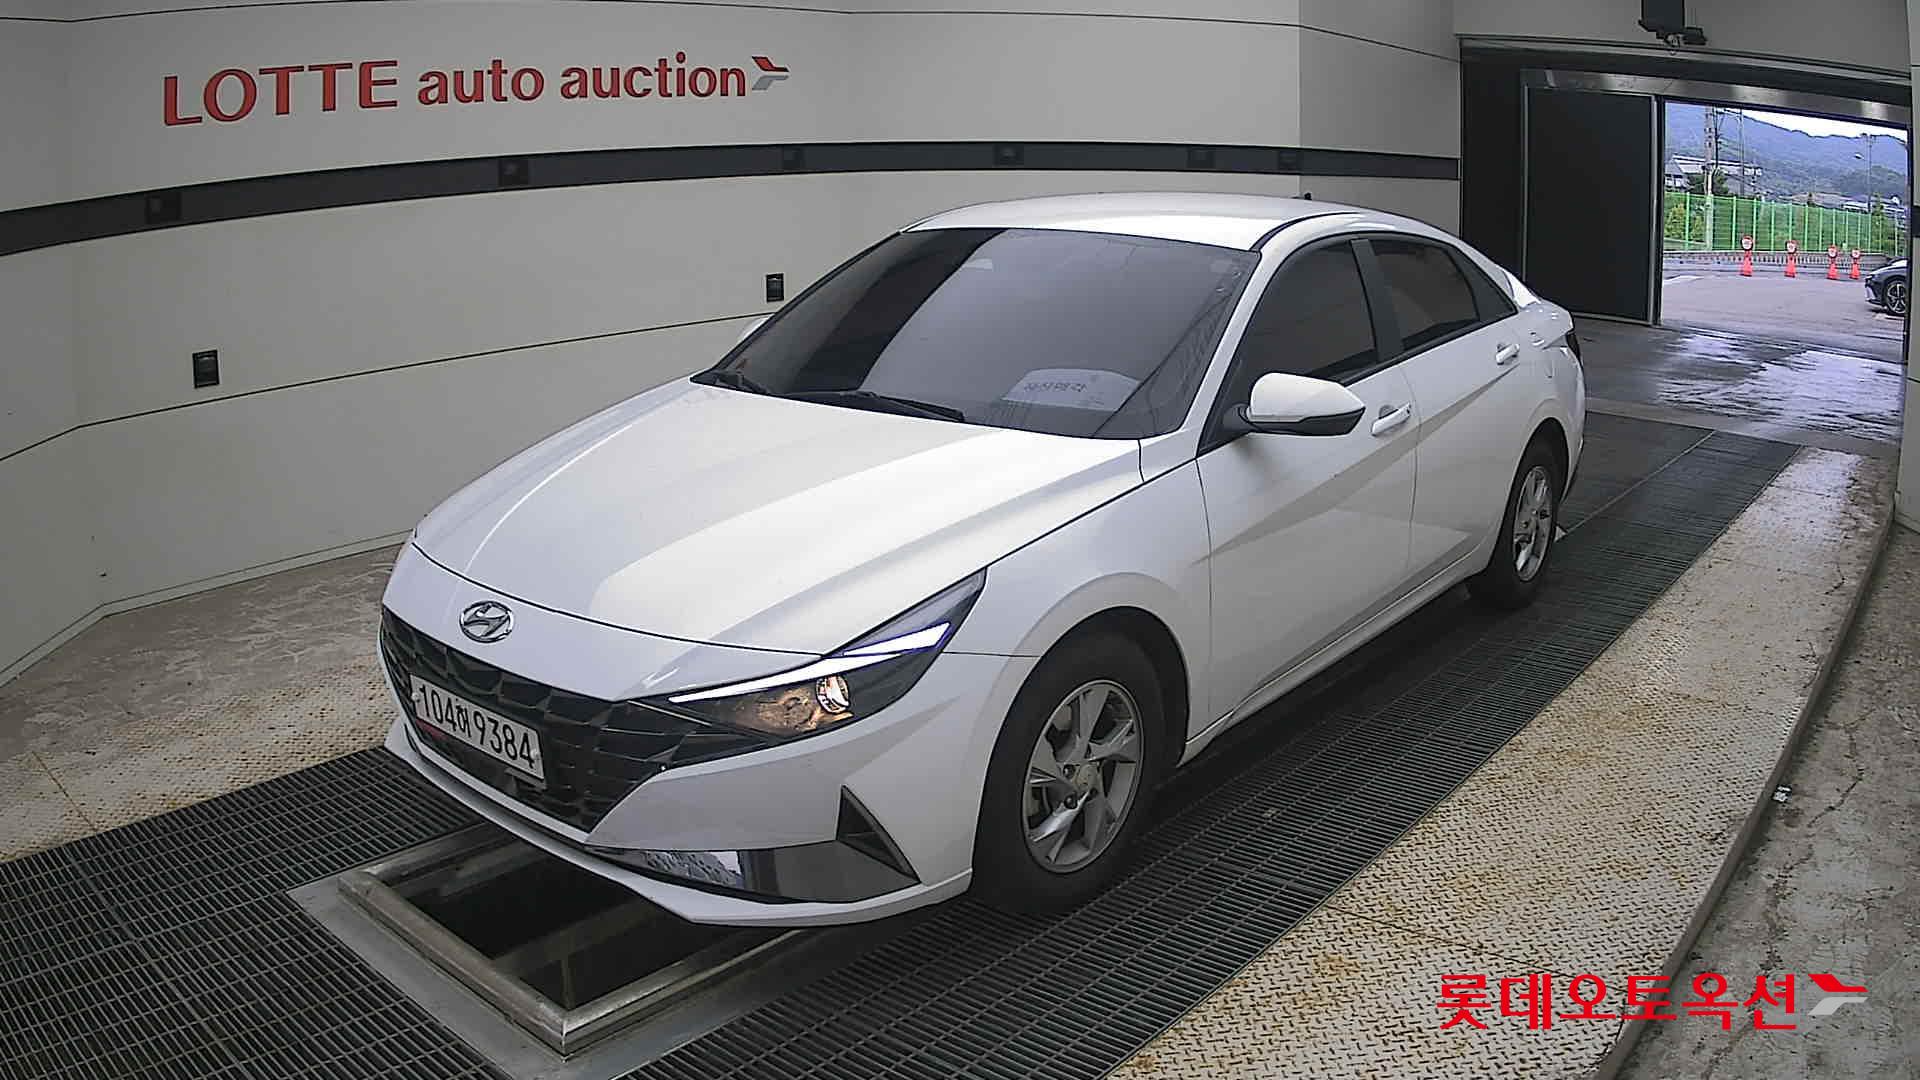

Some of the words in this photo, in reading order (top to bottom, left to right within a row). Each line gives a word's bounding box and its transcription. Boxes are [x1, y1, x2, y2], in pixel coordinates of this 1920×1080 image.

[163, 59, 399, 126] LOTTE
[417, 58, 545, 105] auto
[560, 51, 747, 99] auction
